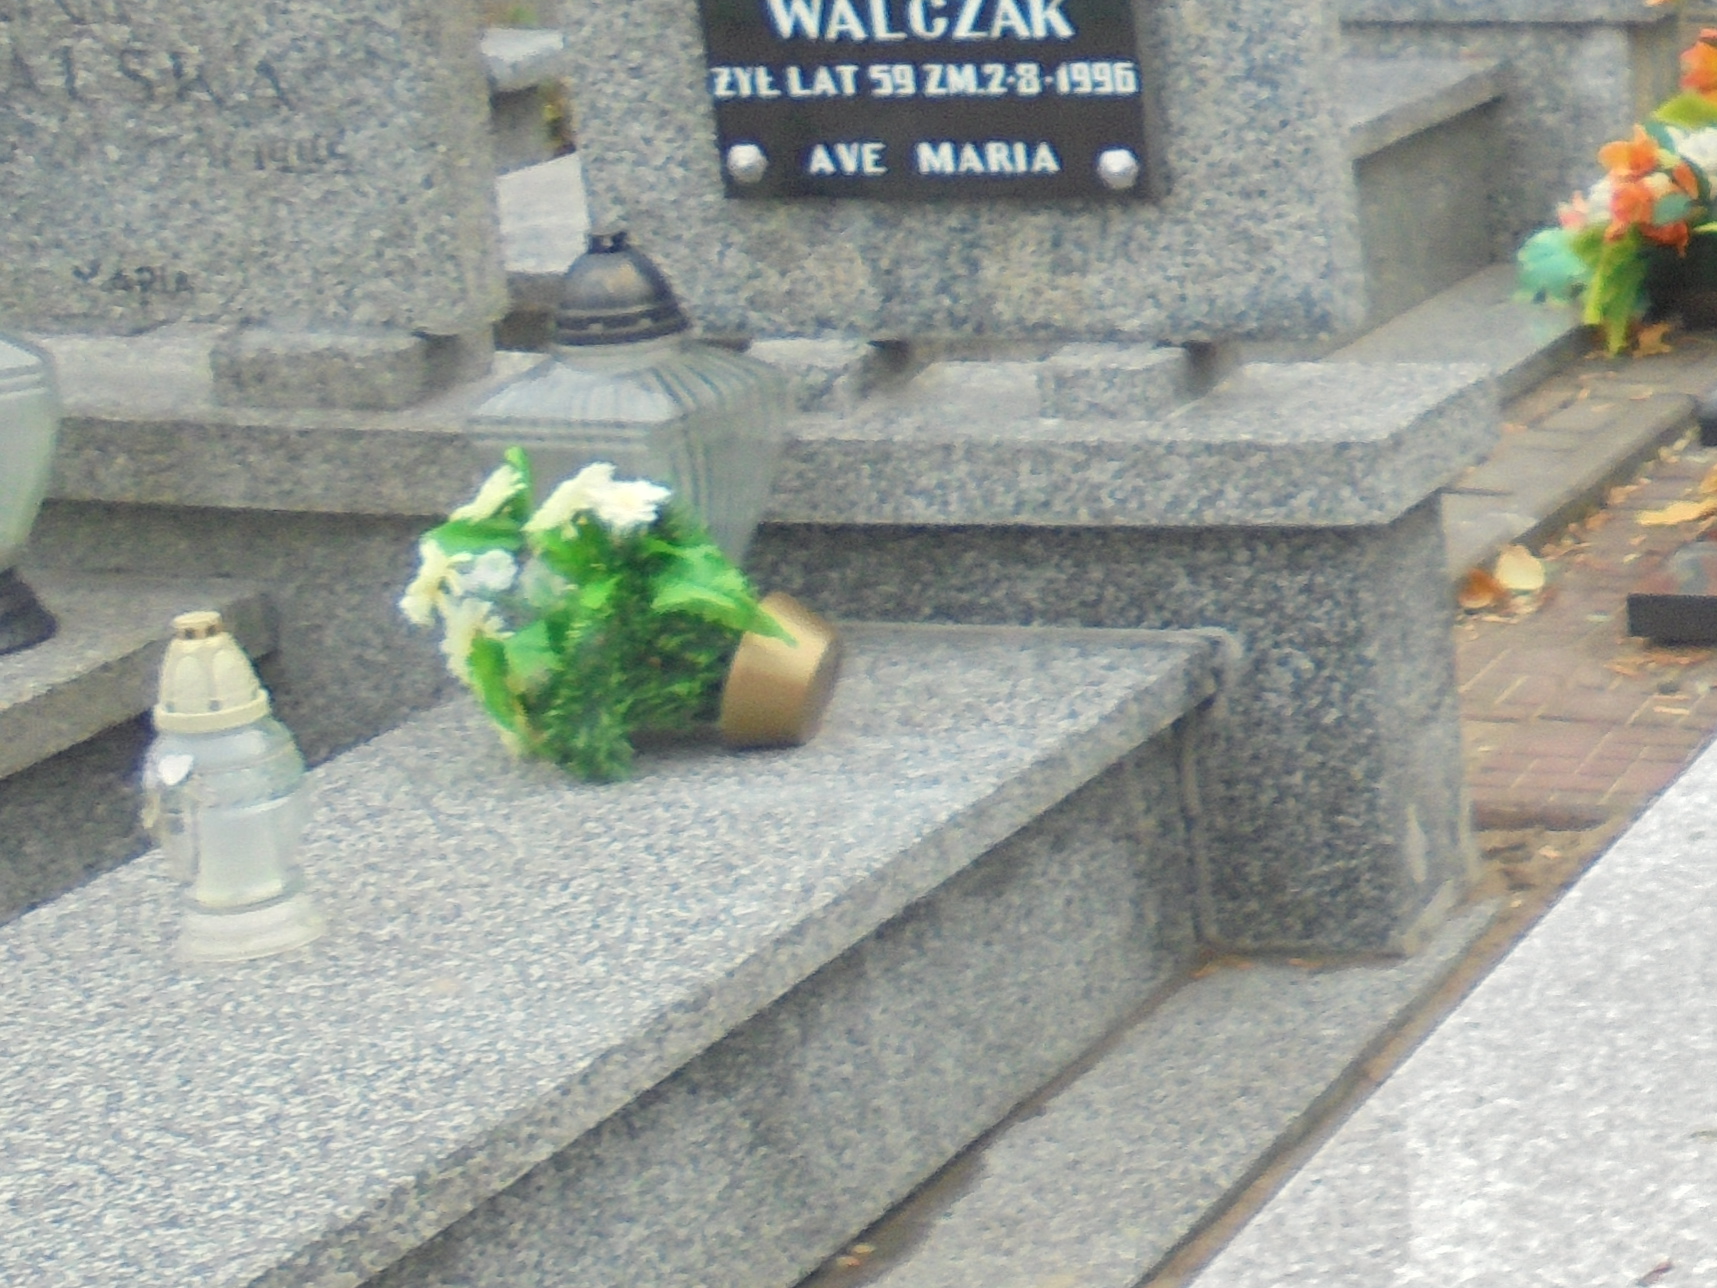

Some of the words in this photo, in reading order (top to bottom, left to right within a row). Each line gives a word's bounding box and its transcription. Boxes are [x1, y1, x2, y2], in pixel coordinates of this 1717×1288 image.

[785, 64, 859, 97] LAT
[868, 62, 917, 97] 59
[809, 141, 889, 176] AVE
[915, 140, 1062, 176] MARIA
